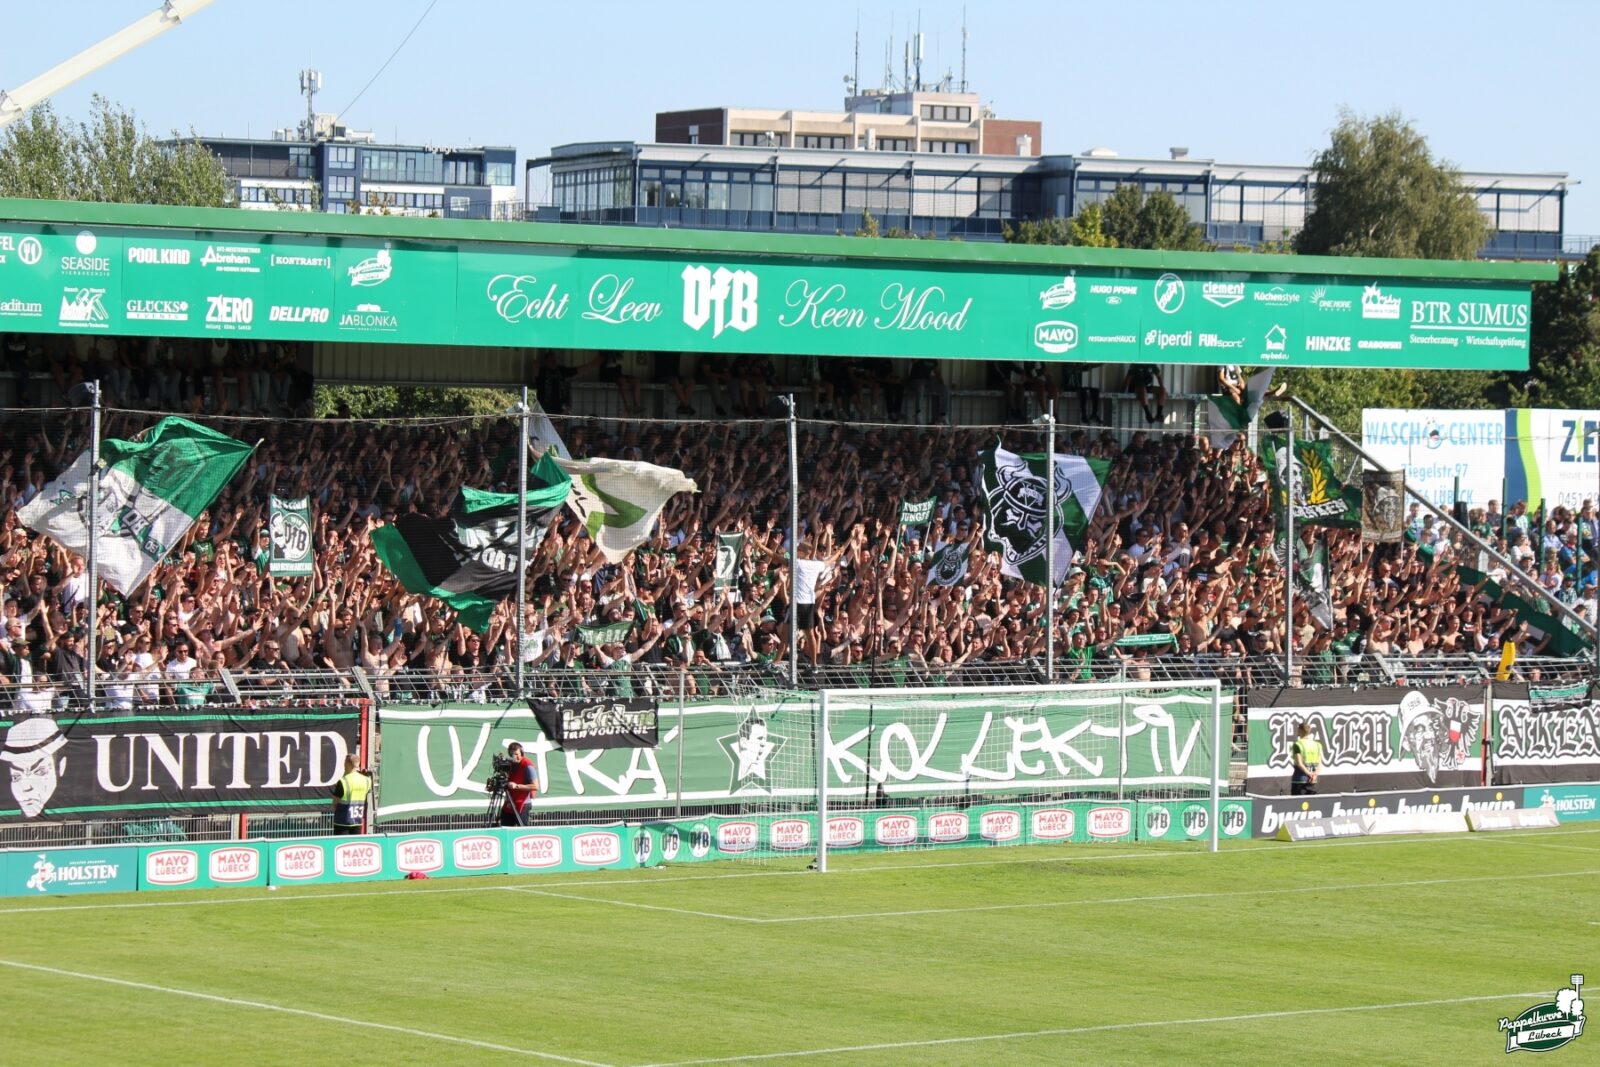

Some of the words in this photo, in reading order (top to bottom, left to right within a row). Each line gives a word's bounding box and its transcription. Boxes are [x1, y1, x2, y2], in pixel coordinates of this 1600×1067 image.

[61, 256, 110, 271] SEASIDE
[1090, 285, 1112, 294] HUGO
[1202, 282, 1245, 295] clement
[487, 274, 570, 323] Echt
[581, 274, 663, 324] Leev
[779, 279, 868, 329] Keen
[873, 282, 974, 332] Mood
[269, 306, 330, 323] DELLPRO
[1410, 301, 1452, 324] BTR
[1458, 302, 1528, 326] SUMUS
[339, 315, 398, 327] JABLONKA
[1039, 328, 1074, 341] MAYO
[1158, 331, 1193, 350] iperdi
[1306, 336, 1352, 352] HINZKE
[1358, 340, 1402, 350] GRABOWSKI
[1409, 333, 1458, 346] Steuerberatung
[1465, 335, 1526, 348] Wirtschaftsprüfung
[1365, 421, 1421, 446] WASCH
[1450, 421, 1504, 446] CENTER
[1434, 485, 1474, 505] LÜBCK
[93, 731, 349, 793] UNITED
[1556, 798, 1597, 811] HOLSTEN
[348, 805, 364, 819] 153
[1094, 812, 1124, 821] MAYO
[936, 817, 962, 827] MAYO
[986, 816, 1014, 824] MAYO
[1038, 814, 1068, 822] MAYO
[776, 824, 804, 834] MAYO
[830, 822, 857, 831] MAYO
[882, 820, 910, 830] MAYO
[1330, 819, 1360, 836] bwin
[724, 826, 750, 836] MAYO
[461, 841, 492, 852] MAYO
[522, 840, 554, 850] MAYO
[580, 838, 612, 848] MAYO
[284, 850, 316, 860] MAYO
[342, 848, 374, 858] MAYO
[404, 844, 434, 855] MAYO
[156, 856, 188, 866] MAYO
[218, 853, 250, 864] MAYO
[58, 864, 119, 881] HOLSTEN
